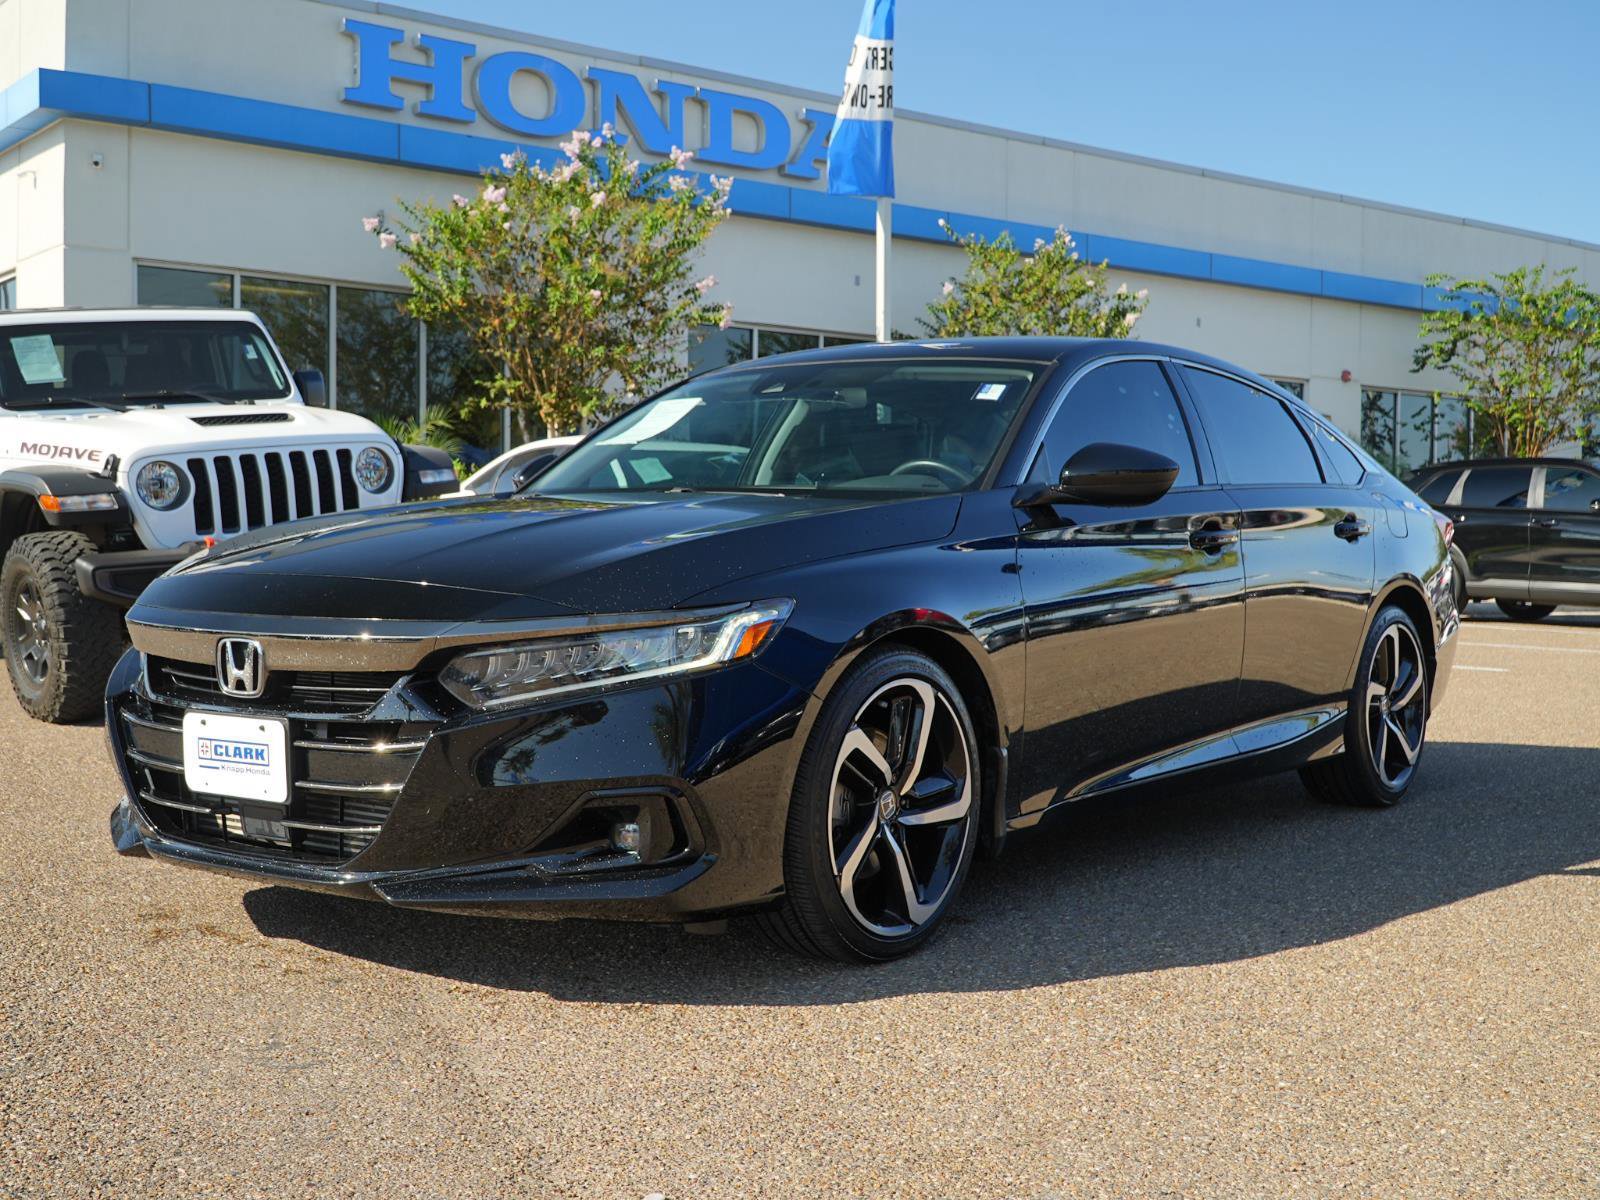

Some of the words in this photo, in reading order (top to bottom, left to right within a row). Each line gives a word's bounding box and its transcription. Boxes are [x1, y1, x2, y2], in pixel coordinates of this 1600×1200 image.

[20, 441, 103, 462] MOJAVE
[213, 744, 266, 761] CLARK
[245, 767, 271, 776] Honda
